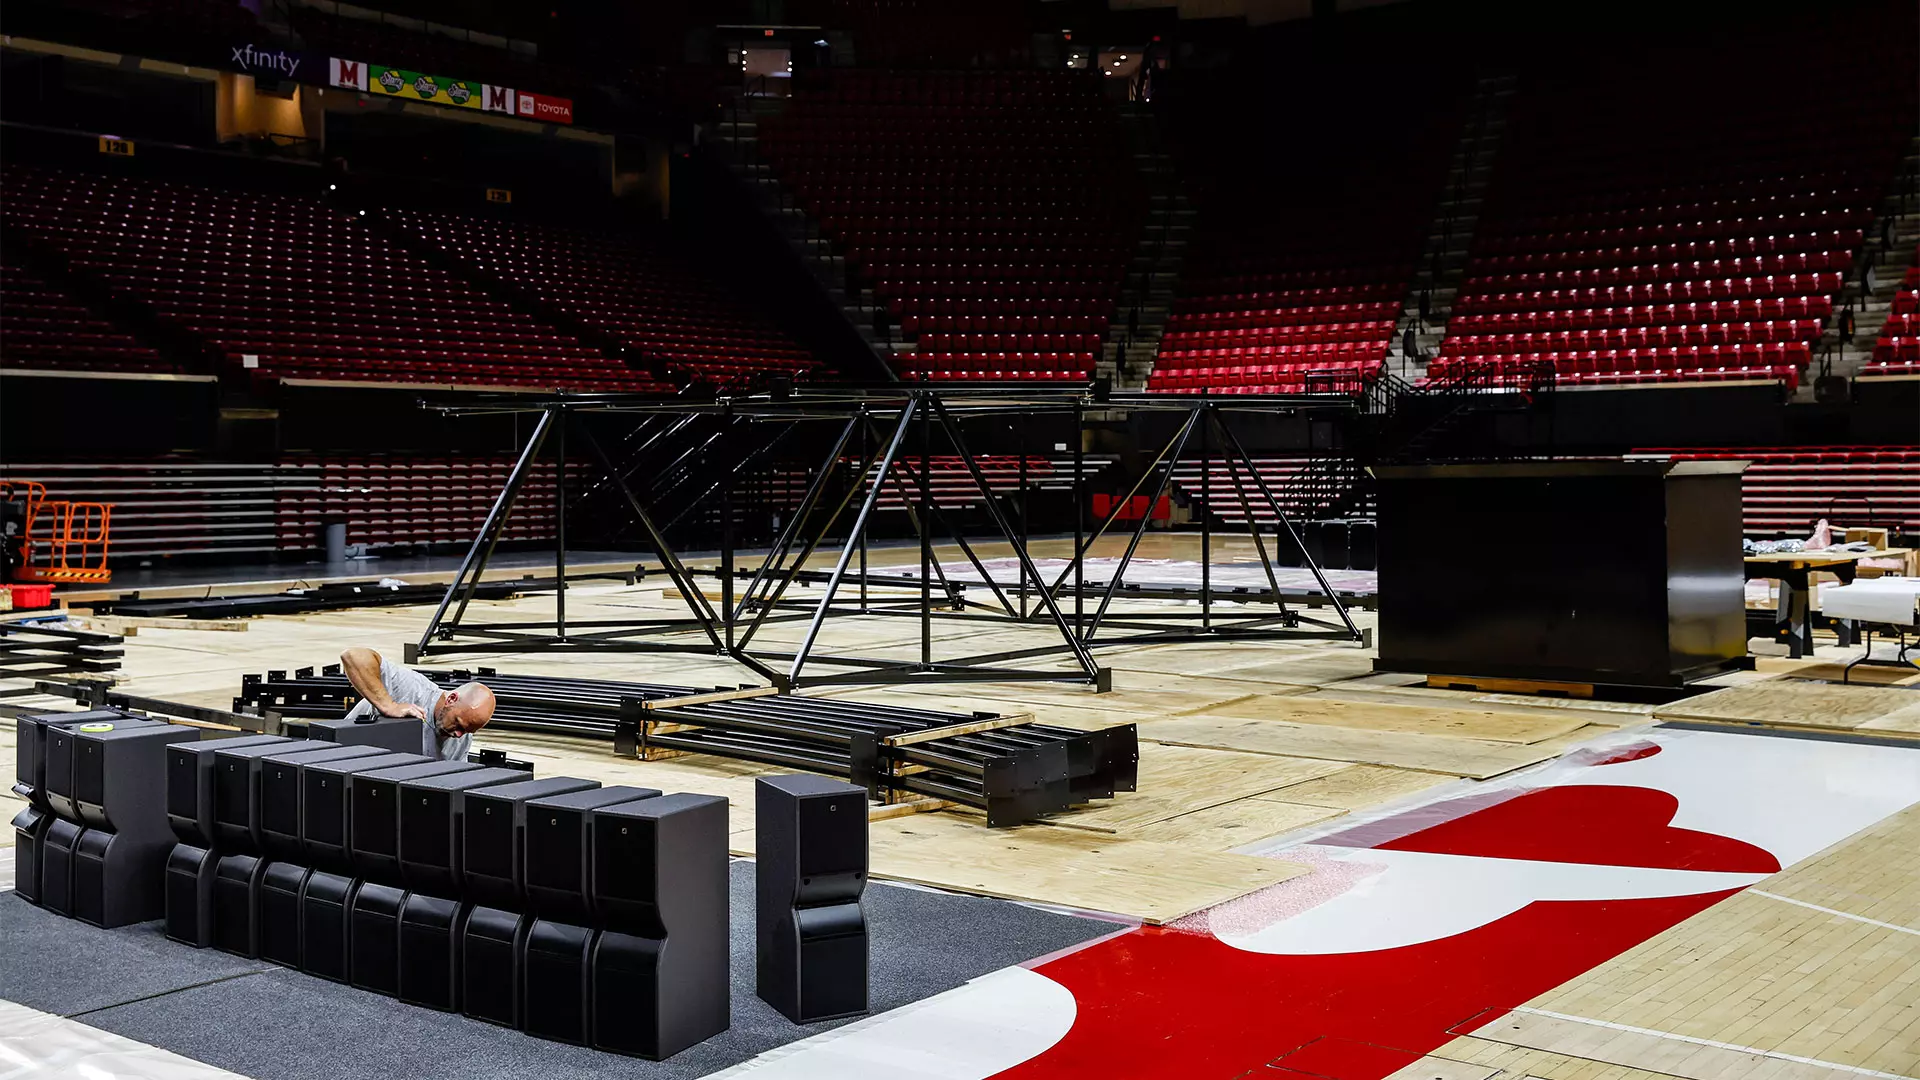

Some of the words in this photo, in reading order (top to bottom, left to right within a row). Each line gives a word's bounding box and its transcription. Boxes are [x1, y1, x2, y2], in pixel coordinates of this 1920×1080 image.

[231, 43, 301, 77] xfinity
[339, 59, 359, 86] M
[489, 85, 507, 110] M
[537, 103, 570, 117] TOYOTA
